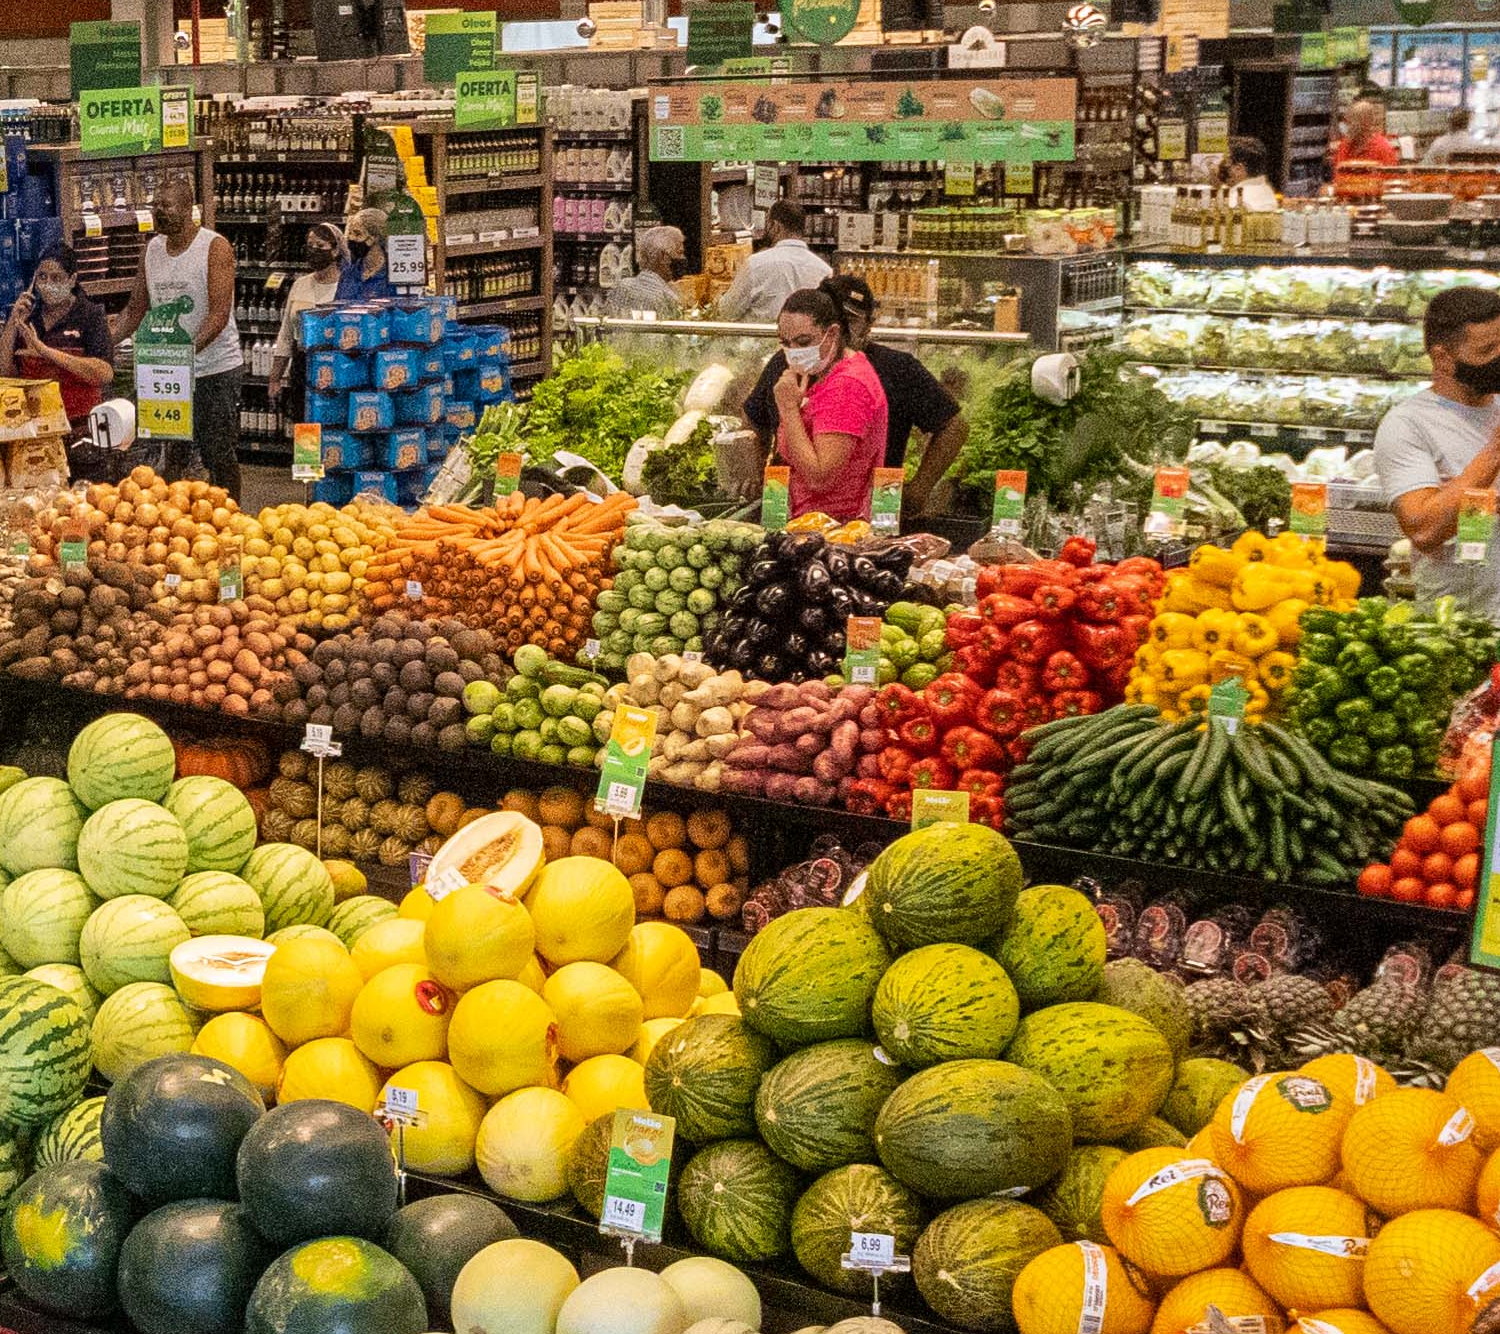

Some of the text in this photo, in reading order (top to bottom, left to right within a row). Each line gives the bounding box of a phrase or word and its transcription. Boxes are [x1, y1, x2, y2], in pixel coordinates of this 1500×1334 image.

[460, 80, 512, 97] OFERTA
[86, 98, 155, 119] OFERTA
[392, 261, 425, 274] 25,99
[153, 382, 181, 395] 5,99
[153, 409, 181, 422] 4,48
[1149, 1170, 1181, 1189] Rei
[613, 1200, 636, 1217] 14,49
[861, 1236, 881, 1252] 6,99
